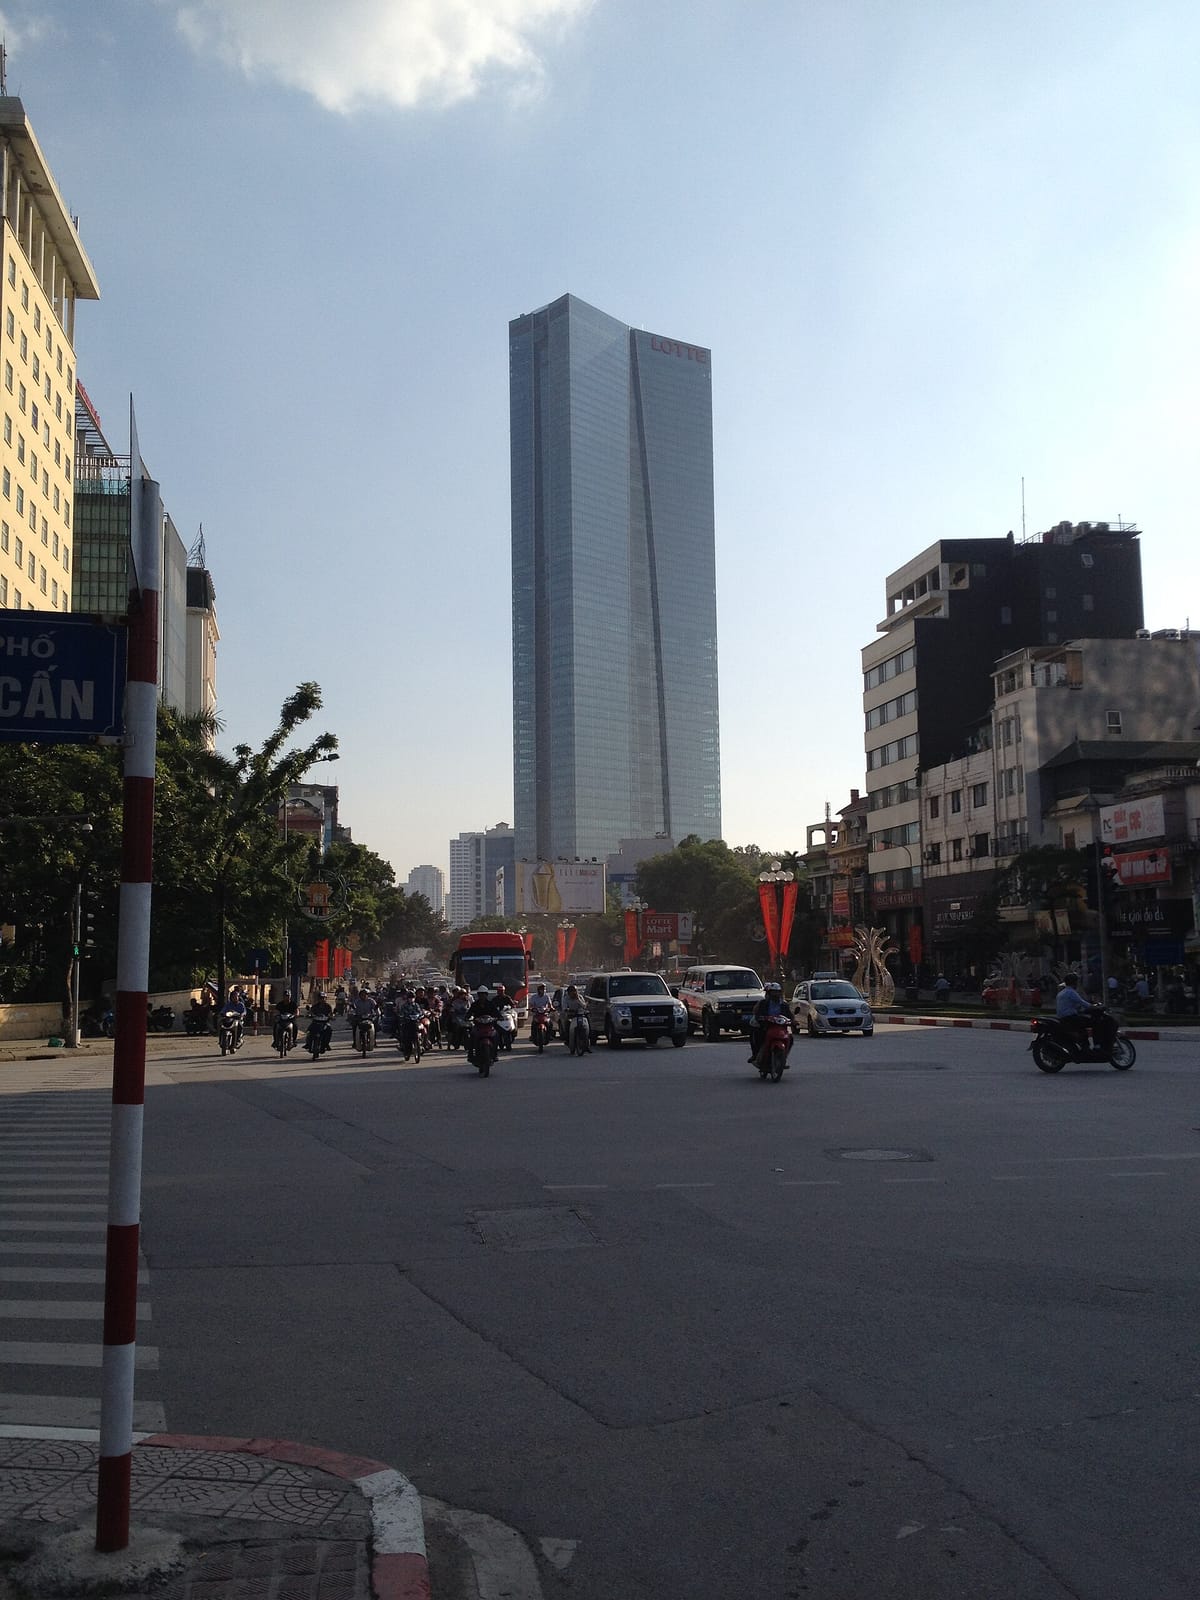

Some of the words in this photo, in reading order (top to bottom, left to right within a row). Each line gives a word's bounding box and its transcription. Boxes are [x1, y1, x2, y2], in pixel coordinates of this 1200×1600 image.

[651, 335, 706, 363] LOTTE
[0, 630, 57, 658] HỐ
[0, 664, 95, 720] CẤN
[647, 924, 673, 934] Mart
